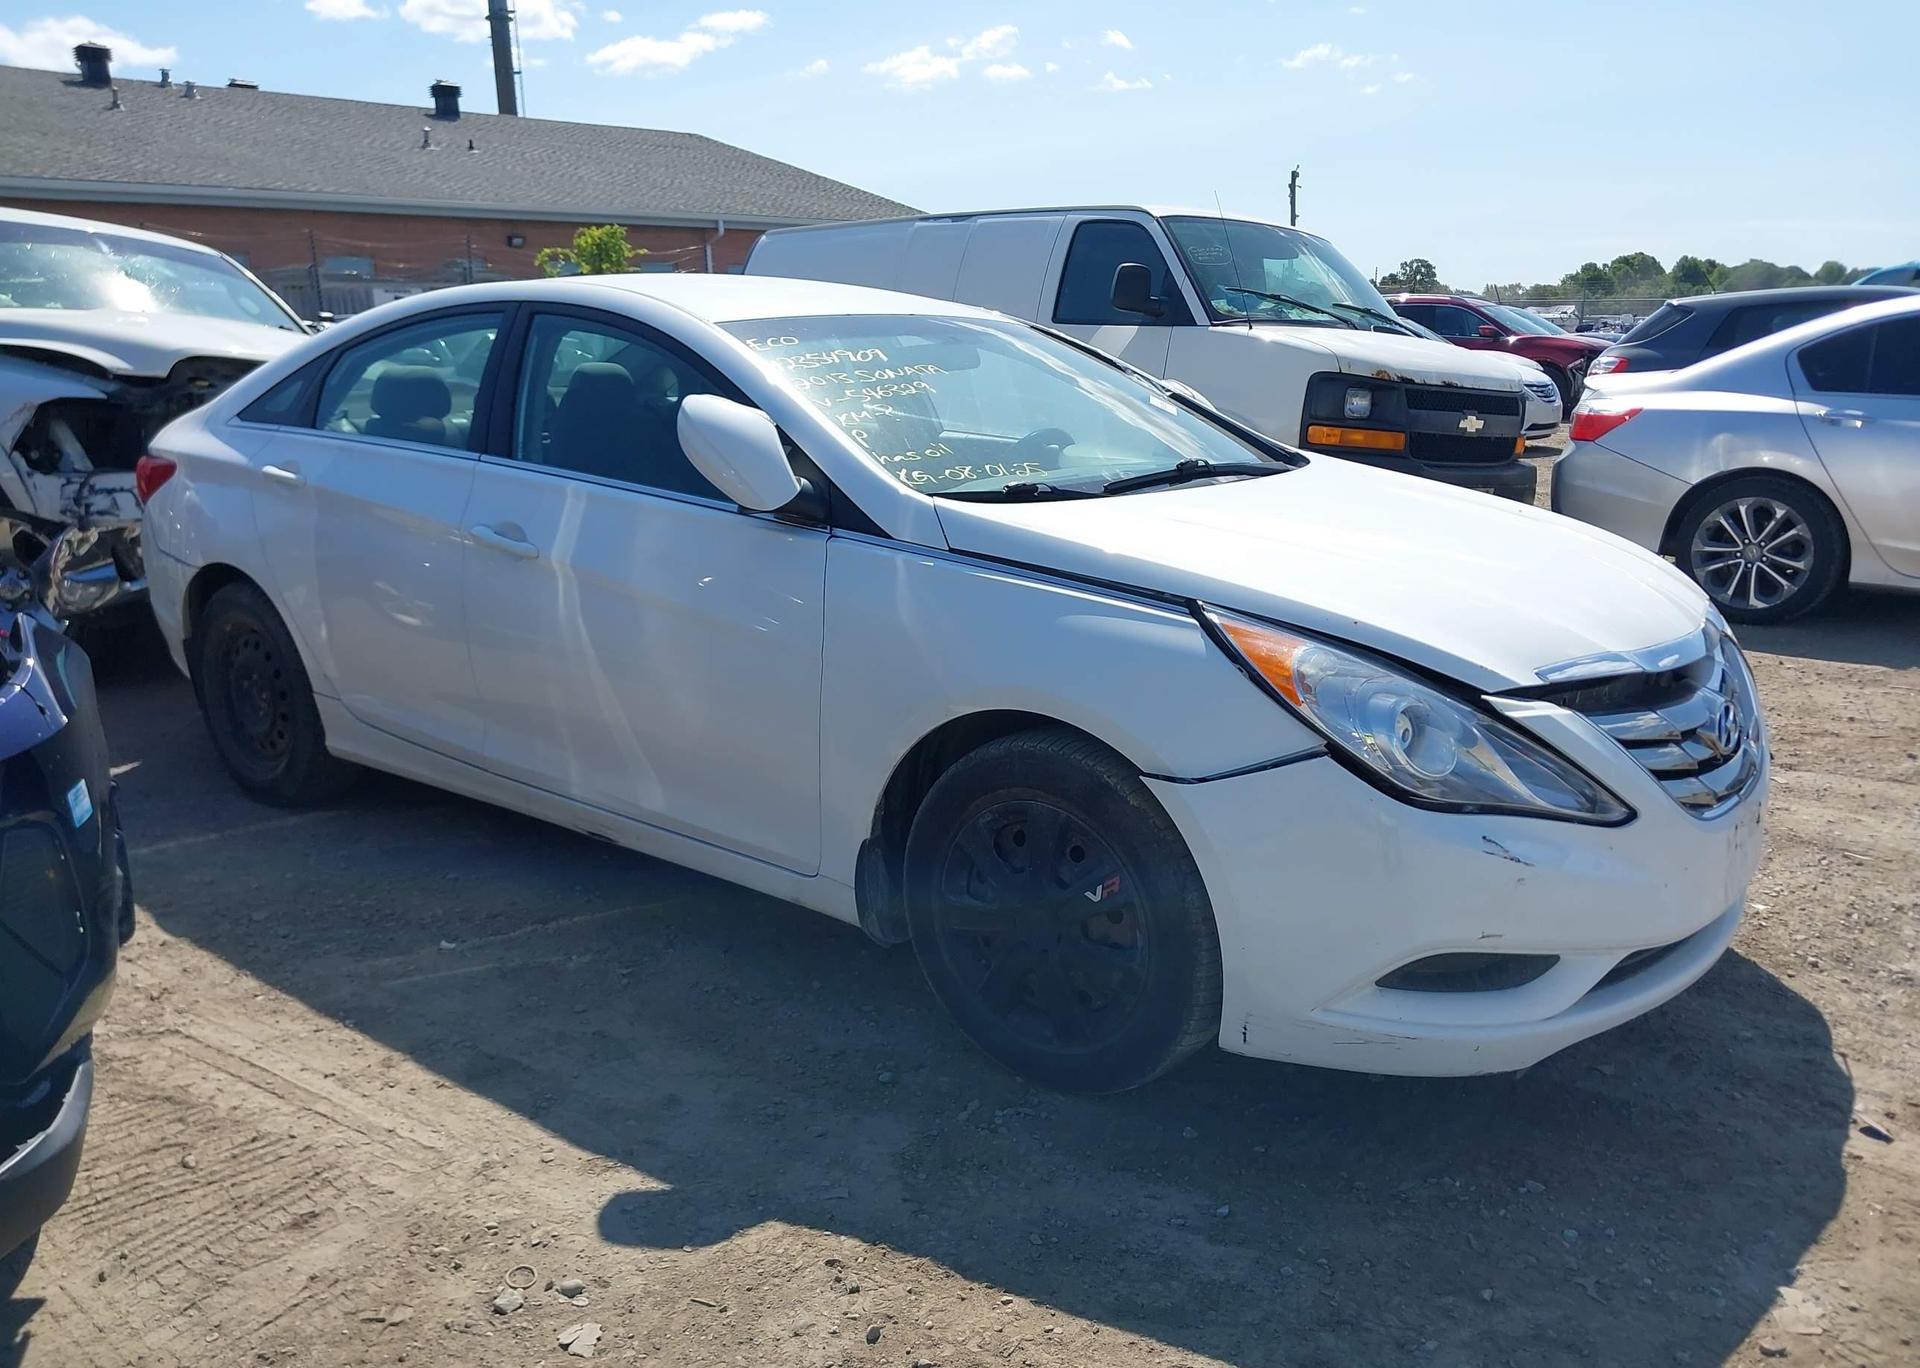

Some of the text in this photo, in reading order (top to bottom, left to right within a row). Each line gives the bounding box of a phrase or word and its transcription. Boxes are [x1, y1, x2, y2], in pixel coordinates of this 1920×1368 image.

[746, 337, 799, 351] ECO
[854, 364, 949, 382] SONATA
[871, 443, 954, 465] has oil
